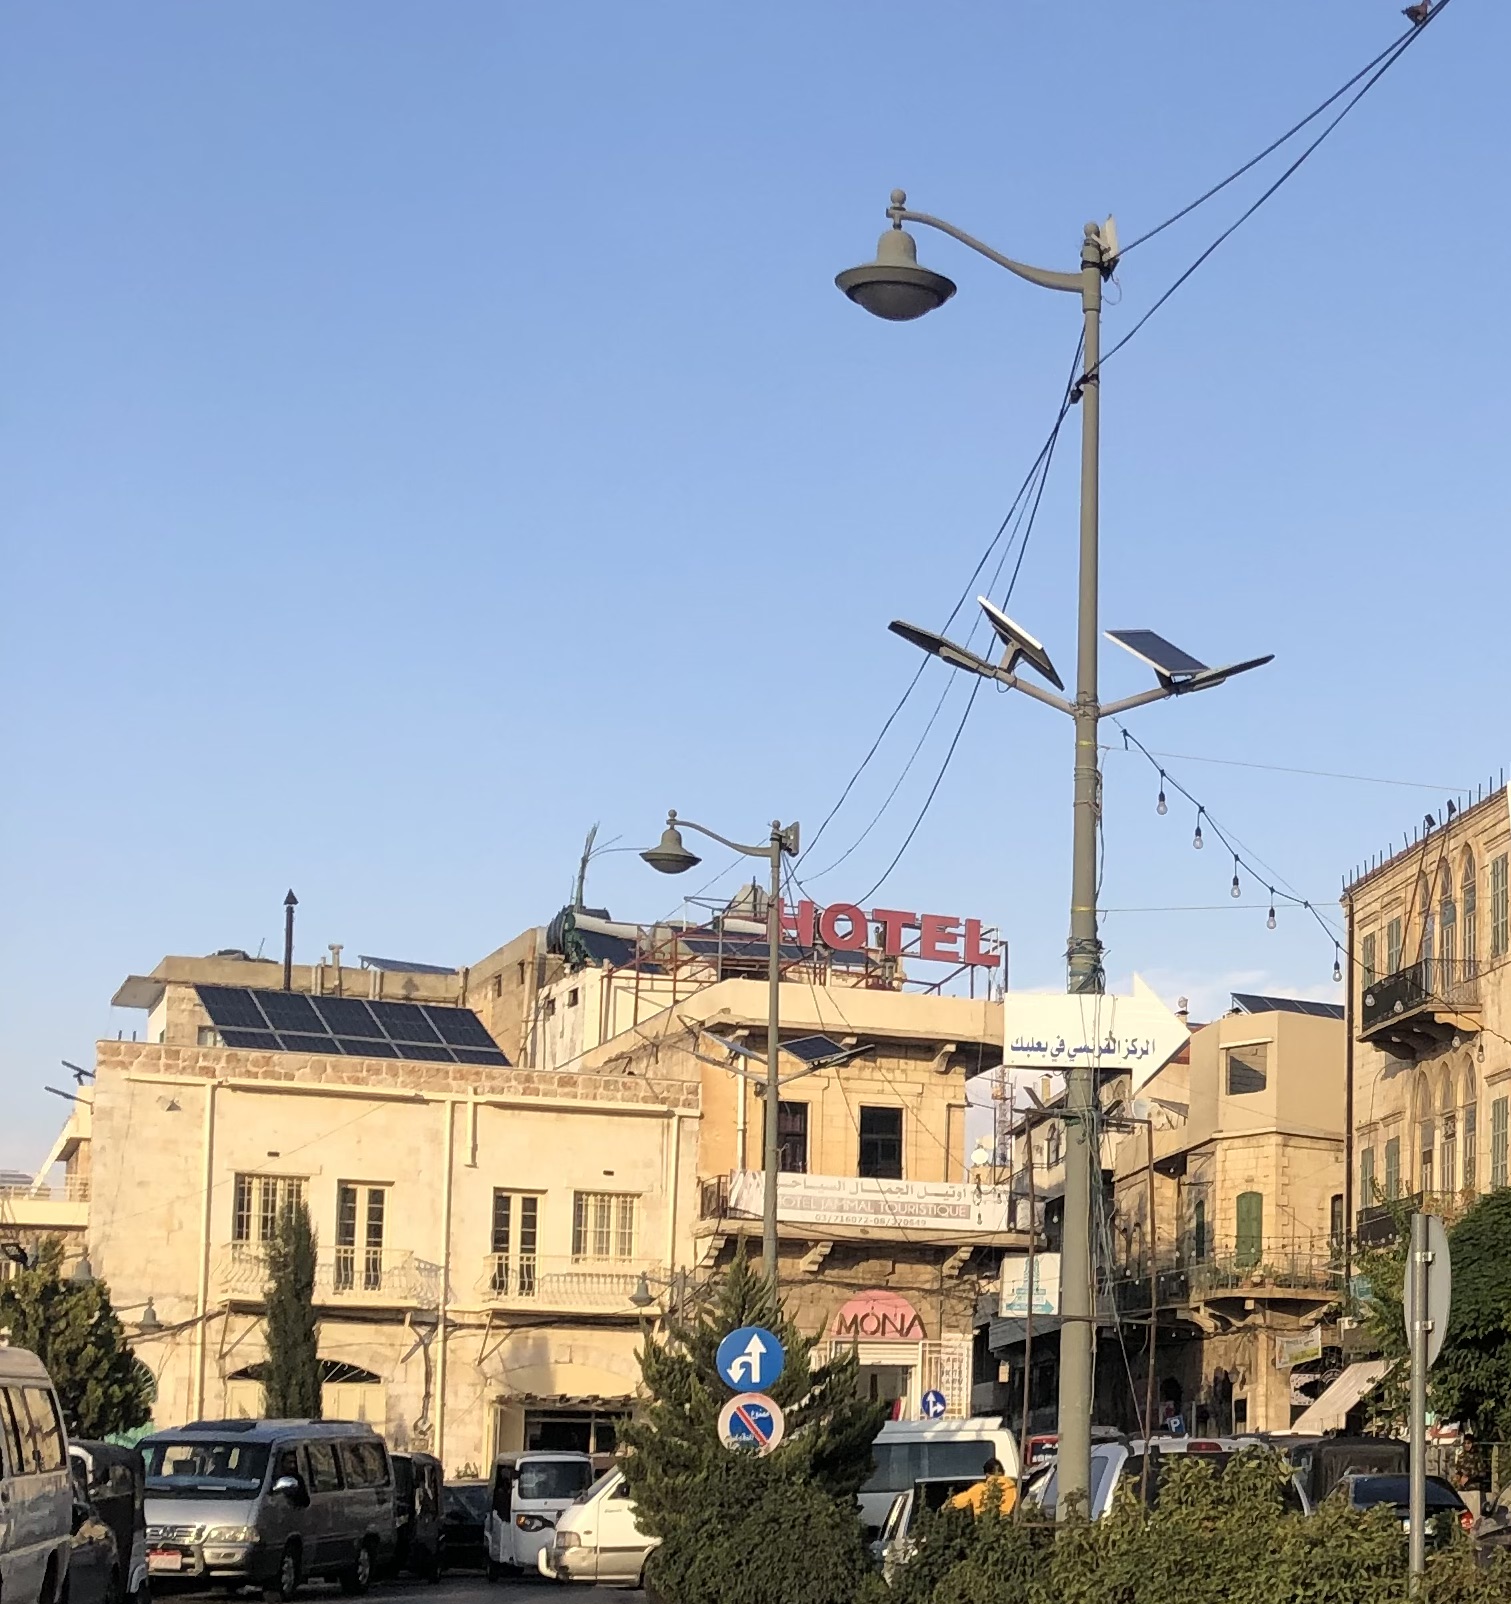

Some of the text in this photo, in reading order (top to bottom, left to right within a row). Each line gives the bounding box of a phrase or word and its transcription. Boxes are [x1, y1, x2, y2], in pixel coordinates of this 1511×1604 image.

[768, 898, 1000, 967] HOTEL
[1010, 1035, 1049, 1059] بعلبك
[1049, 1035, 1067, 1063] في
[777, 1178, 847, 1194] السياح
[820, 1198, 875, 1212] JAMMAL
[879, 1201, 967, 1218] TOURISTIQUE
[836, 1311, 929, 1338] MONA
[1170, 1418, 1180, 1432] P
